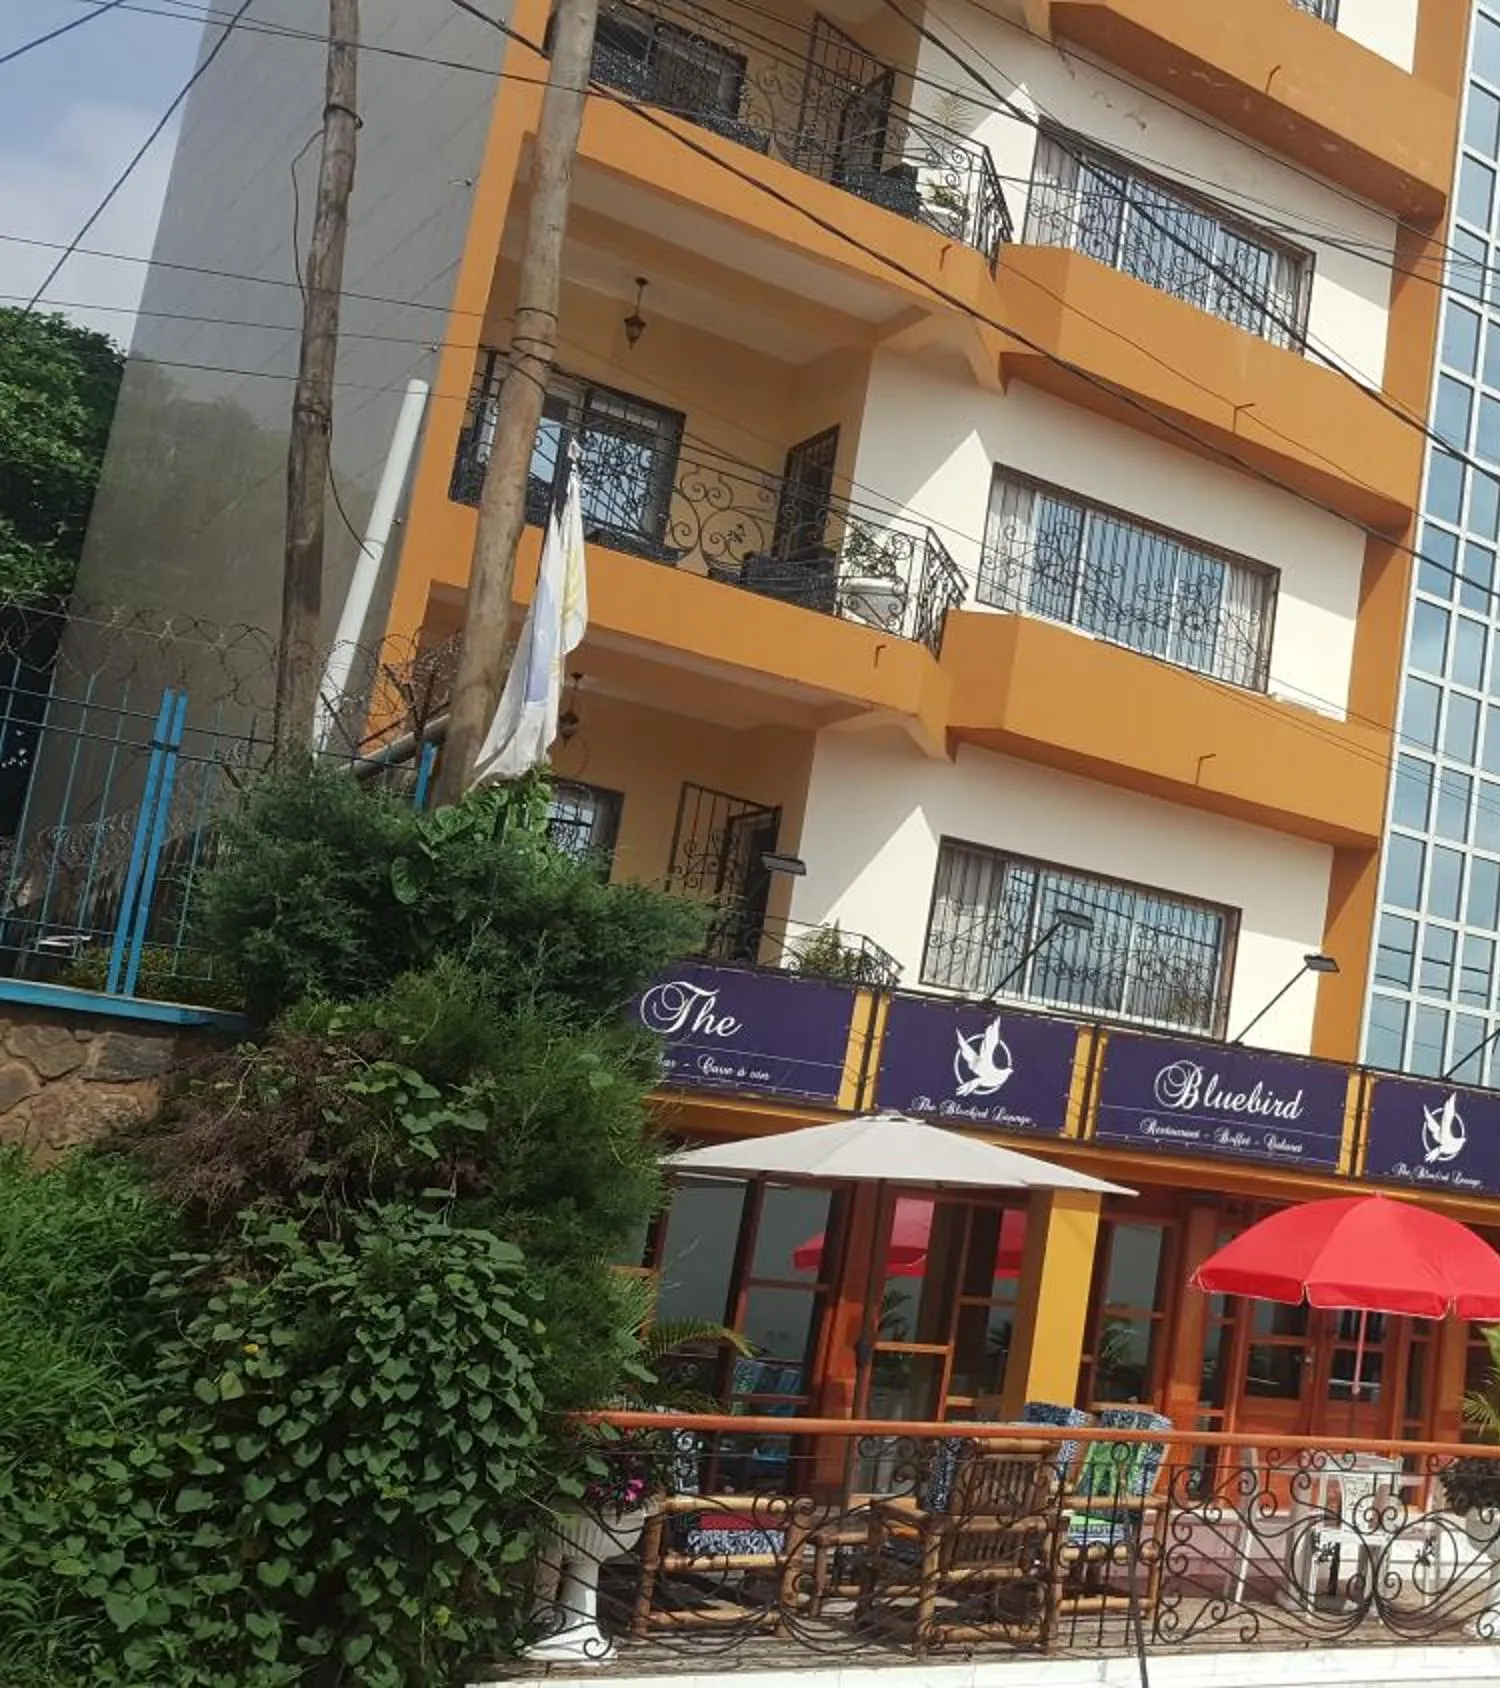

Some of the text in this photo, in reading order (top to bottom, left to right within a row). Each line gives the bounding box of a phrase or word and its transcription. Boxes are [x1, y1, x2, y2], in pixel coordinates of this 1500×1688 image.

[640, 981, 742, 1038] The
[697, 1054, 733, 1075] Cave
[1154, 1059, 1304, 1120] Bluebird
[911, 1096, 936, 1111] The
[939, 1099, 989, 1119] Bluebird
[1139, 1117, 1200, 1139] Restaurant
